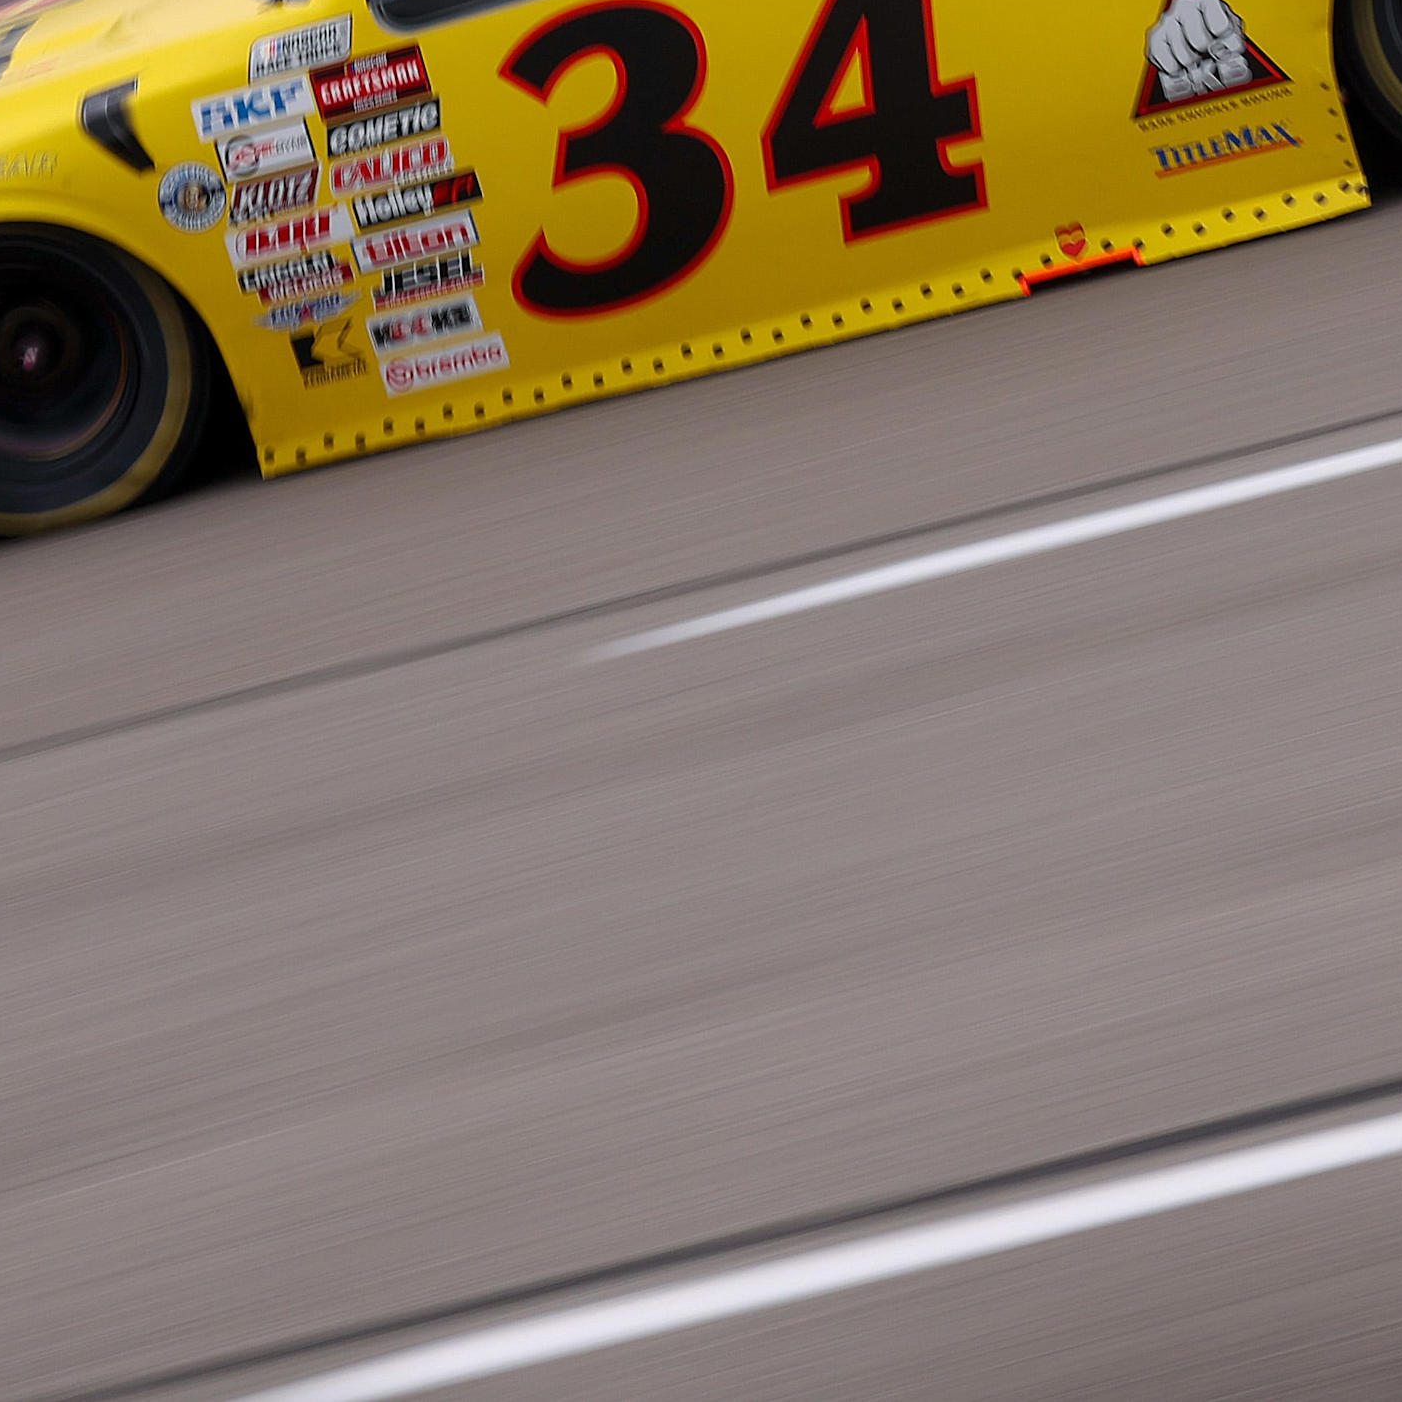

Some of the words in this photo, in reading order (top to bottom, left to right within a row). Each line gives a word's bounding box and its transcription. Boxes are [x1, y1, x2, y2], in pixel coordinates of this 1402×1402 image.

[320, 59, 420, 106] CRAFTSMAN
[200, 79, 304, 134] SKF
[329, 100, 440, 156] COMETIC
[354, 182, 435, 228] Holley
[414, 342, 503, 378] brembo
